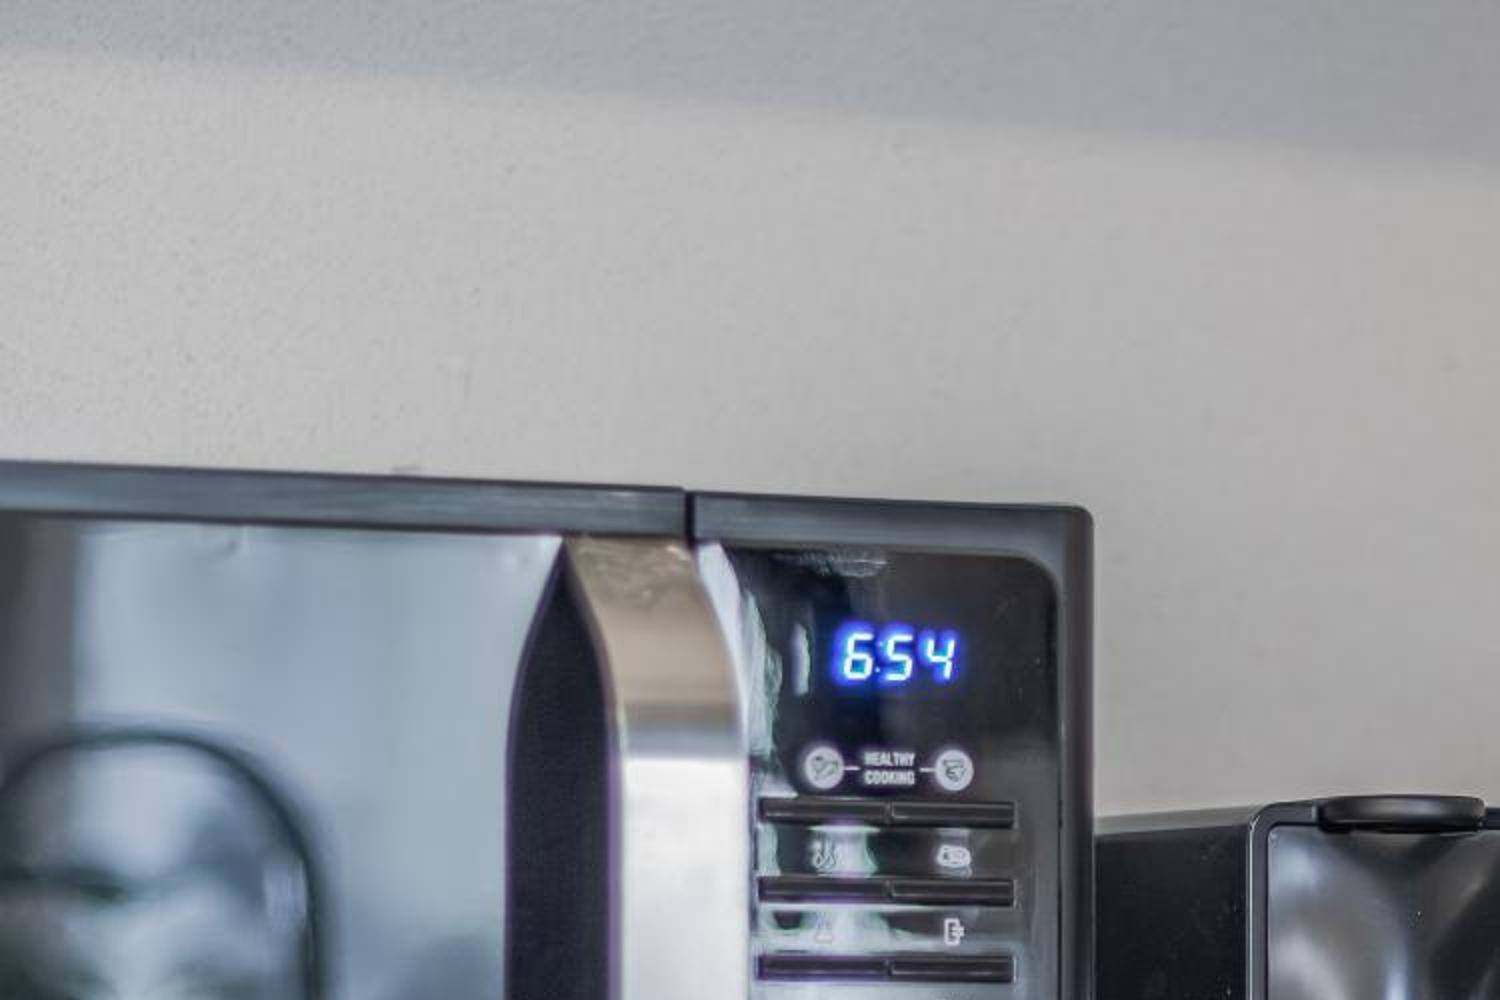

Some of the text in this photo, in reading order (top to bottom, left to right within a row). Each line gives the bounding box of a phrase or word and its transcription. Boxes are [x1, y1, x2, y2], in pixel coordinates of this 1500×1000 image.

[842, 632, 956, 682] 6:54
[863, 751, 916, 767] HEALTHY
[863, 770, 916, 785] COOKING
